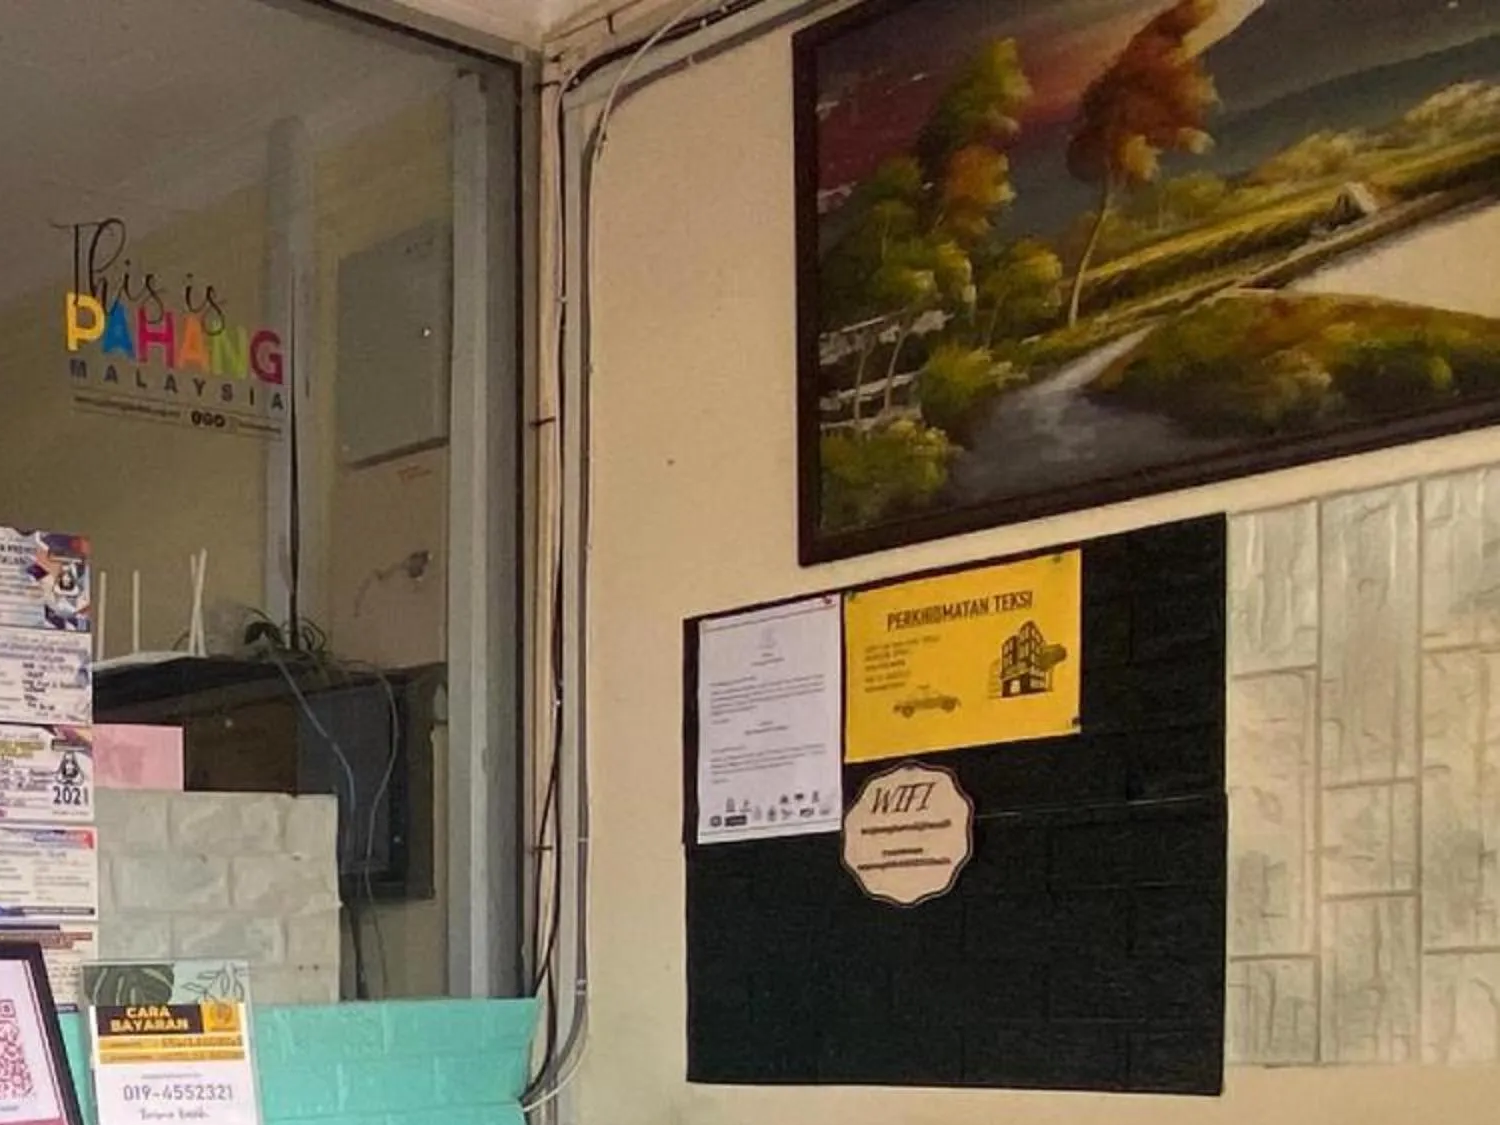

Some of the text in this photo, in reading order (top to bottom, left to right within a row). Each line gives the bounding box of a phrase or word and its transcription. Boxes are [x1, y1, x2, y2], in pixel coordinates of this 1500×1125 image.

[185, 272, 227, 336] is
[66, 291, 285, 385] PAHANG
[69, 358, 285, 411] MALAYSIA
[993, 590, 1033, 613] TEKSI
[53, 785, 88, 806] 2021
[871, 781, 937, 814] WIFI
[126, 1006, 171, 1018] CARA
[110, 1018, 189, 1032] BAYARAN
[123, 1084, 233, 1101] 019-4552321
